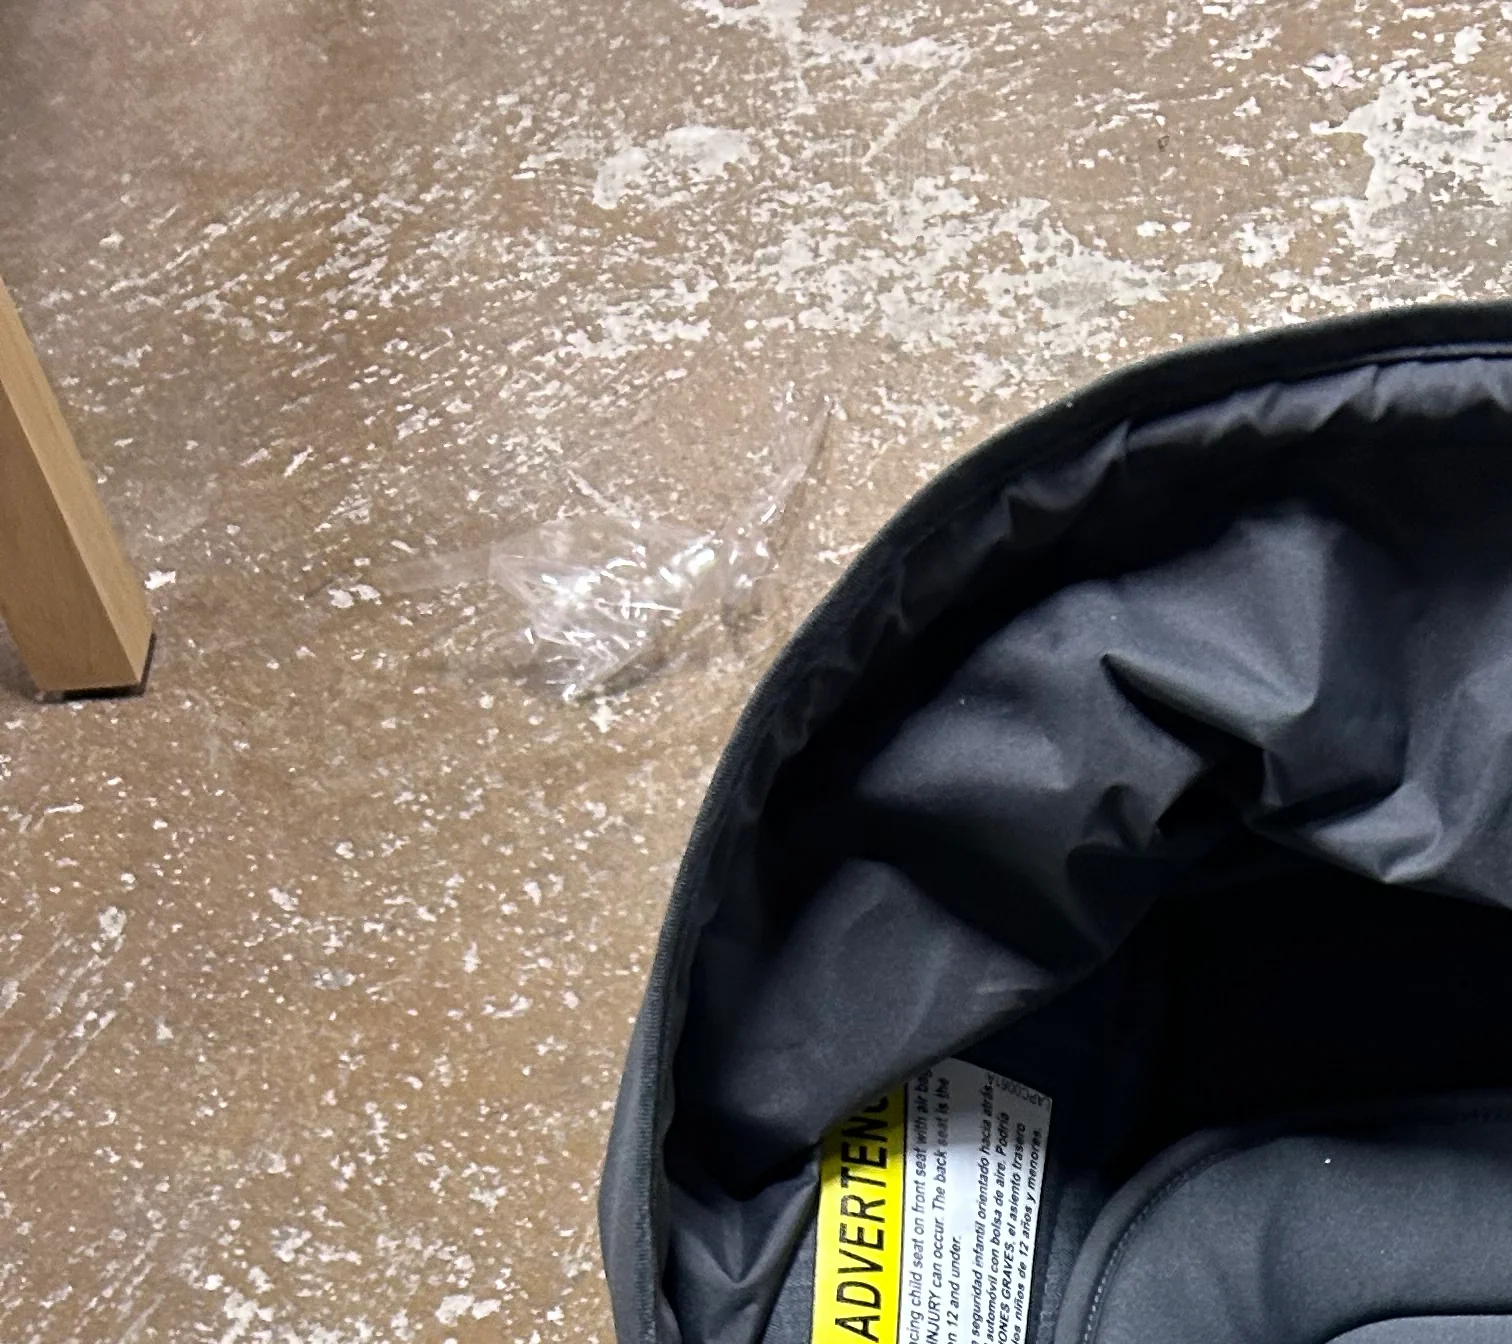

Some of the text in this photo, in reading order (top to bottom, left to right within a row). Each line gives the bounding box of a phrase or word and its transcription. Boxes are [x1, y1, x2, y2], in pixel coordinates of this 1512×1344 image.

[913, 1093, 930, 1114] air
[934, 1076, 951, 1100] the
[935, 1100, 949, 1115] is
[911, 1115, 929, 1145] with
[933, 1115, 950, 1147] seat
[978, 1118, 992, 1155] hacia
[1011, 1121, 1026, 1170] trasero
[911, 1146, 928, 1177] seat
[931, 1147, 949, 1184] back
[910, 1178, 927, 1214] front
[930, 1184, 946, 1212] The
[973, 1156, 991, 1219] orientado
[992, 1188, 1004, 1207] de
[1006, 1171, 1021, 1222] asiento
[1025, 1191, 1037, 1204] y
[913, 1216, 925, 1236] on
[989, 1207, 1003, 1246] bolsa
[1006, 1221, 1016, 1236] el
[1019, 1203, 1033, 1240] años
[908, 1237, 925, 1269] seat
[946, 1233, 963, 1278] under.
[970, 1220, 985, 1268] infantil
[1018, 1240, 1029, 1257] 12
[931, 1262, 943, 1288] can
[989, 1247, 1000, 1273] con
[1016, 1260, 1027, 1279] de
[906, 1270, 924, 1307] child
[945, 1279, 961, 1309] and
[966, 1268, 987, 1337] seguridad
[1012, 1281, 1025, 1321] niños
[945, 1309, 959, 1328] 12
[981, 1273, 999, 1342] automóvil
